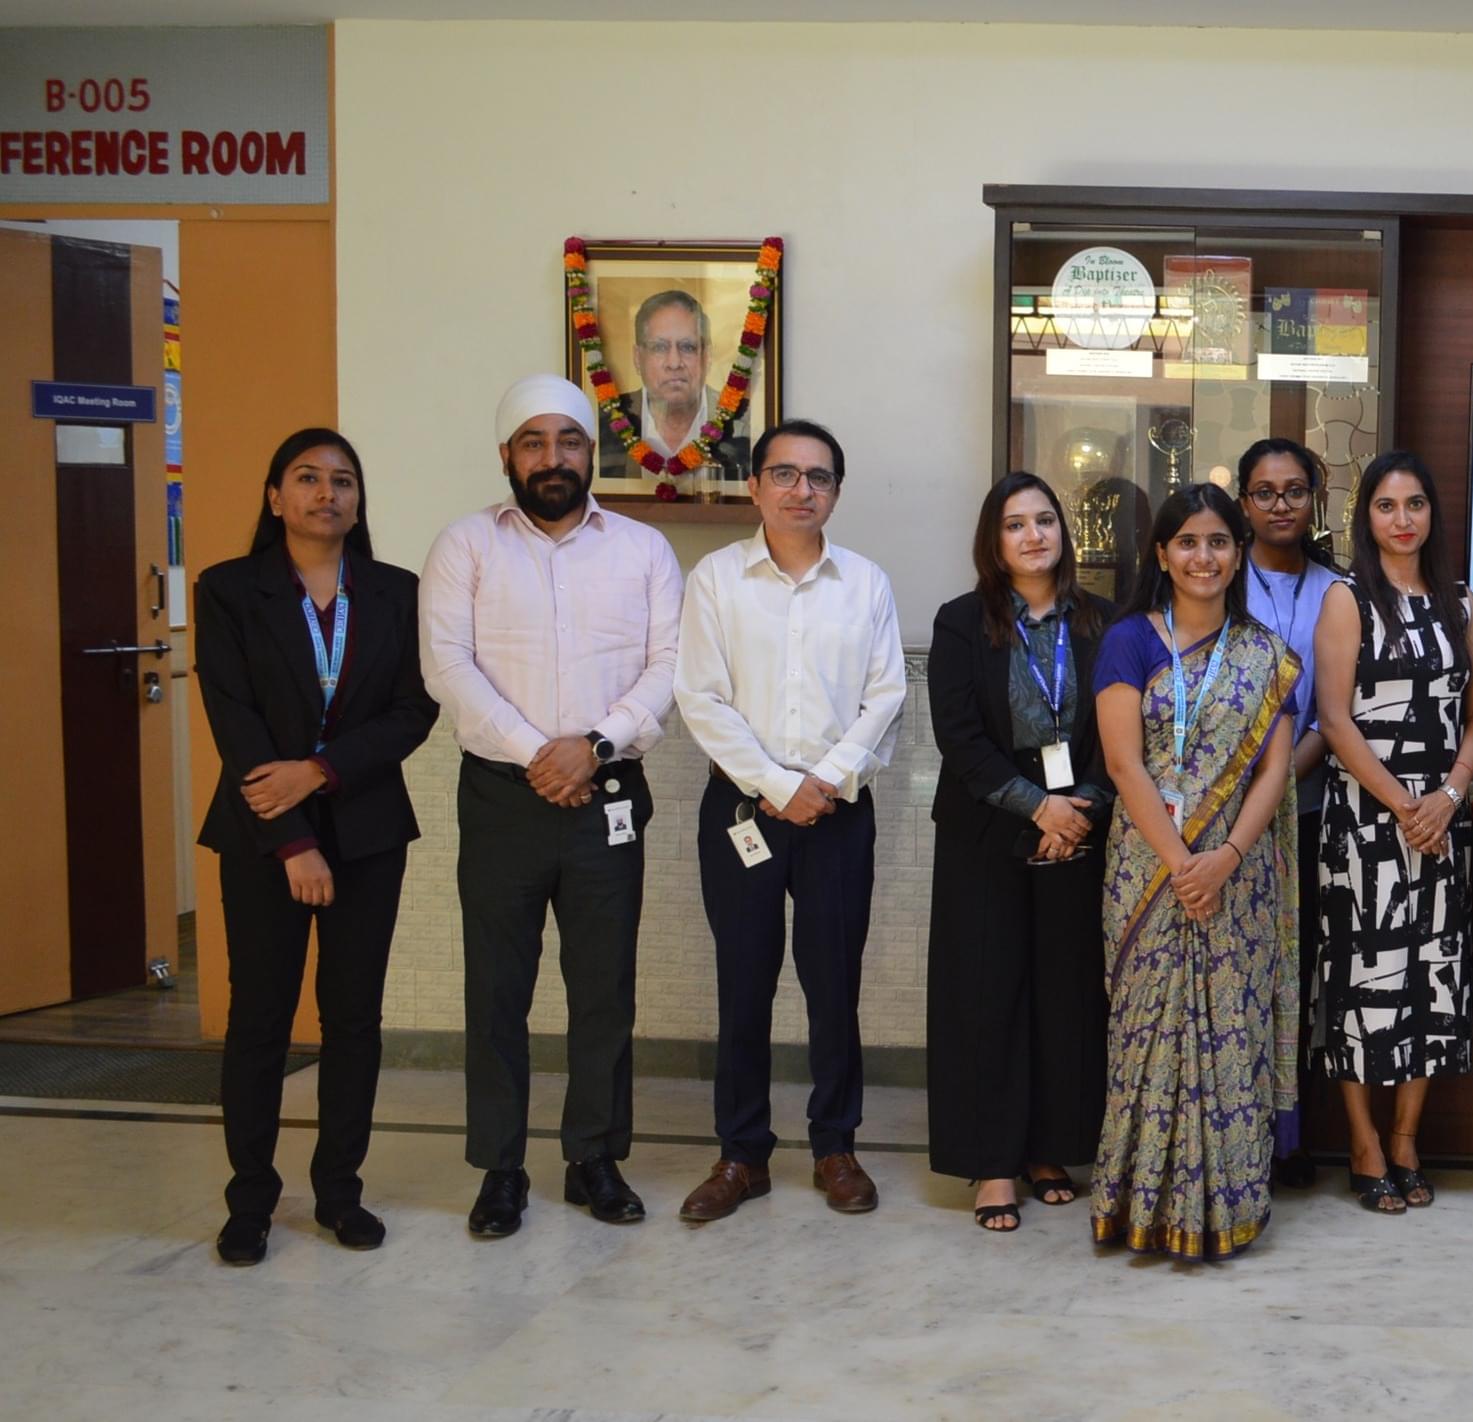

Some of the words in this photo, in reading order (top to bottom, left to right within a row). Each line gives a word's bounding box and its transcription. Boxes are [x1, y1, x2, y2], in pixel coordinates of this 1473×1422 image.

[45, 78, 152, 112] B-005
[0, 129, 170, 176] FERENCE
[181, 130, 306, 176] ROOM
[1071, 265, 1138, 283] Baptizer
